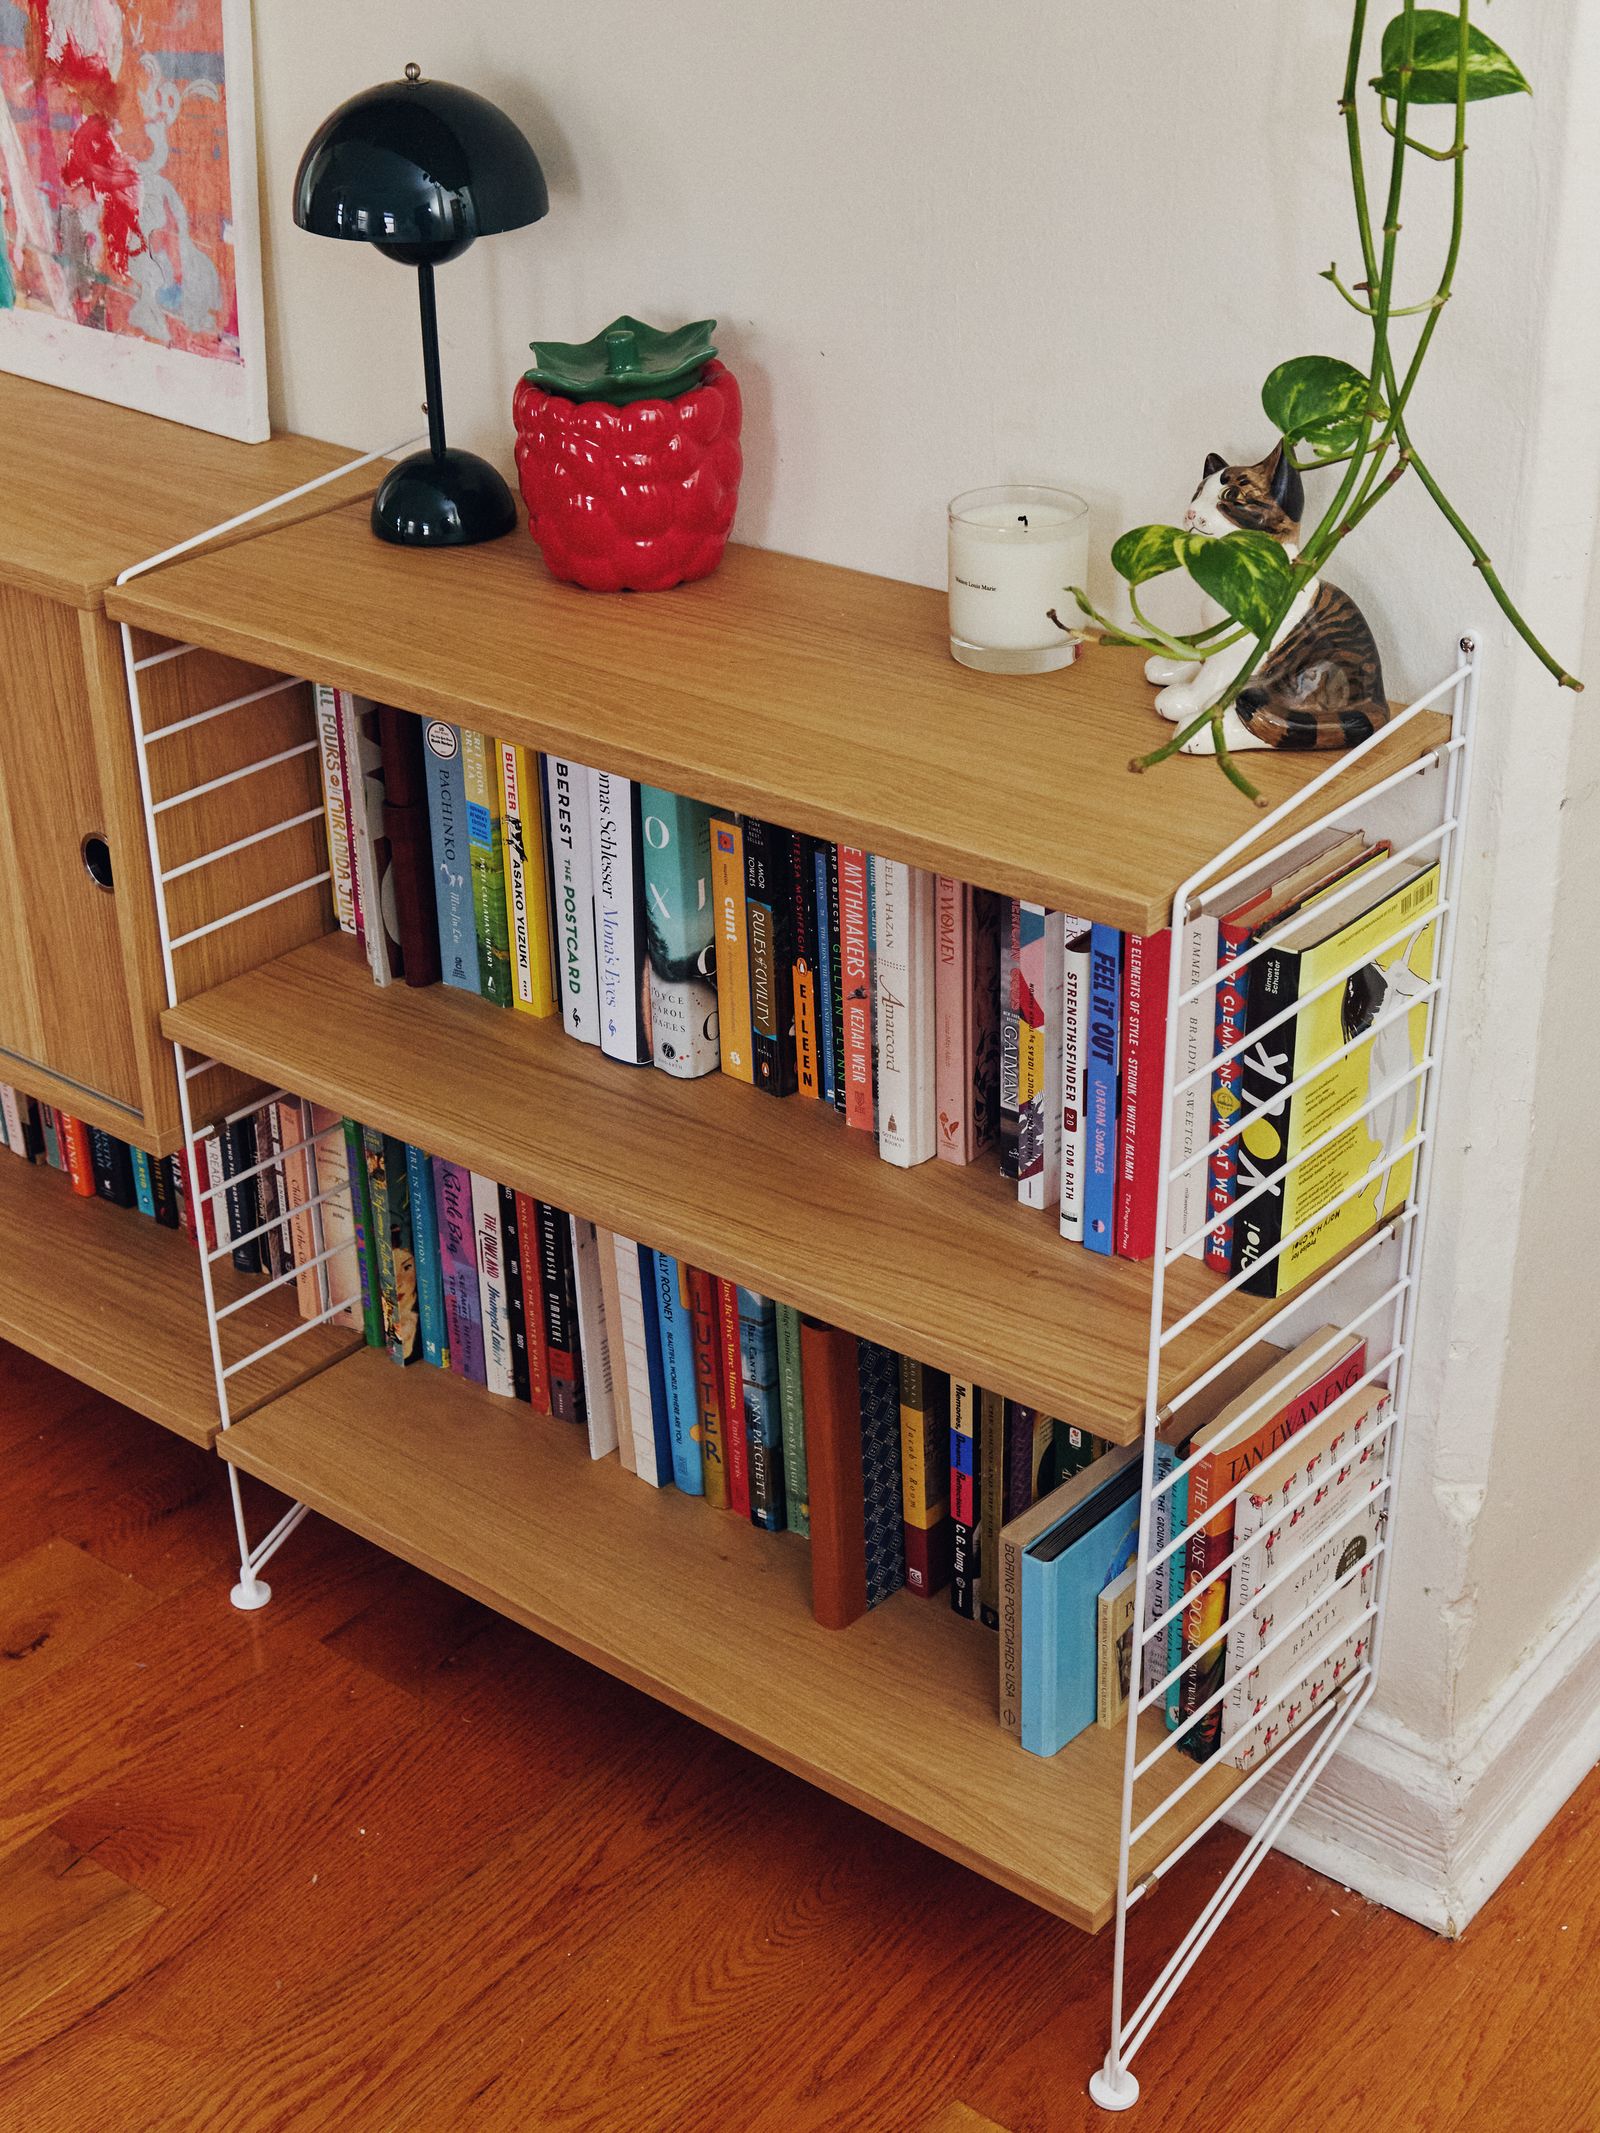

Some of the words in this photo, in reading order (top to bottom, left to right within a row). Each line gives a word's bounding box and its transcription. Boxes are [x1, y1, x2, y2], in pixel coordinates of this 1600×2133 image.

[968, 581, 981, 590] Louis
[981, 584, 997, 592] Marie
[321, 713, 340, 771] FOURS
[505, 752, 516, 811] BUTTER
[439, 768, 456, 861] PACHINKO
[556, 762, 573, 850] BEREST
[329, 796, 350, 880] MIRANDA
[563, 858, 572, 882] THE
[600, 818, 618, 899] Schlesser
[748, 856, 756, 887] TOWLES
[757, 861, 765, 889] AMOR
[512, 859, 524, 911] ASAKO
[339, 884, 355, 931] JULY
[724, 897, 737, 942] cunt
[795, 885, 805, 953] MOSHFEGH
[844, 861, 865, 978] MYTHMAKERS
[516, 916, 528, 969] YUZUKI
[563, 885, 581, 994] POSTCARD
[602, 905, 620, 964] Mona's
[752, 909, 767, 955] RULES
[886, 903, 894, 949] HAZAN
[940, 896, 955, 966] WOMEN
[485, 938, 493, 968] HENRY
[601, 968, 620, 1008] Eyes
[833, 943, 843, 1016] GILLIAN
[1093, 950, 1116, 992] FEEL
[1129, 948, 1142, 999] ELEMENTS
[1265, 969, 1273, 993] Simon
[1272, 960, 1281, 995] Schuster
[651, 986, 685, 1005] JOYCE
[652, 1002, 685, 1019] CAROL
[755, 968, 769, 1027] CIVILITY
[1129, 1001, 1140, 1015] OF
[653, 1015, 686, 1033] OATES
[799, 984, 813, 1087] EILEEN
[850, 1007, 865, 1050] KEZIAH
[879, 974, 905, 1073] Amarcord
[1028, 1036, 1035, 1044] by
[1065, 971, 1078, 1102] STRENGTHSFINDER
[1128, 1016, 1140, 1047] STYLE
[836, 1027, 846, 1080] FLYNN
[1027, 1046, 1035, 1071] IDEAS
[1091, 1022, 1115, 1067] OUT
[852, 1054, 866, 1084] WEIR
[1003, 1025, 1018, 1106] GAIMAN
[1126, 1058, 1139, 1099] STRUNK
[1093, 1080, 1108, 1127] JORDAN
[1126, 1107, 1137, 1136] WHITE
[66, 1136, 78, 1170] KING
[1066, 1143, 1075, 1167] TOM
[1094, 1127, 1107, 1175] SONDLER
[1124, 1143, 1136, 1181] KALMAN
[412, 1177, 420, 1189] IN
[443, 1168, 463, 1220] Rattle
[1065, 1171, 1075, 1201] RATH
[1214, 1178, 1228, 1205] WE
[413, 1192, 426, 1264] TRANSLATION
[483, 1213, 496, 1234] THE
[508, 1225, 515, 1235] UP
[1123, 1204, 1132, 1230] Penguin
[446, 1222, 463, 1255] Bag
[479, 1230, 500, 1279] LOWLAND
[1122, 1231, 1130, 1250] Press
[523, 1233, 532, 1281] MICHAELS
[659, 1252, 670, 1276] ALLY
[458, 1272, 469, 1318] SEAMUS
[485, 1282, 500, 1331] Jhumpa
[513, 1299, 521, 1310] MY
[660, 1277, 673, 1322] ROONEY
[721, 1280, 731, 1303] Just
[529, 1310, 537, 1345] WINTER
[549, 1293, 562, 1343] DIMANCHE
[724, 1304, 732, 1318] Be
[516, 1333, 525, 1350] BODY
[666, 1331, 676, 1363] BEAUTIFUL
[726, 1319, 735, 1341] Five
[747, 1324, 756, 1344] BEL
[532, 1352, 540, 1378] VAULT
[728, 1343, 737, 1369] More
[748, 1347, 758, 1382] CANTO
[695, 1291, 721, 1464] LUSTER
[729, 1369, 738, 1410] Minutes
[785, 1368, 794, 1410] CLAIRE
[671, 1392, 680, 1414] WHERE
[750, 1393, 761, 1427] ANN
[955, 1384, 966, 1430] Memories,
[674, 1429, 682, 1445] YOU
[1227, 1441, 1264, 1482] TAN
[1323, 1363, 1360, 1411] ENG
[753, 1428, 766, 1500] PATCHETT
[789, 1438, 797, 1458] SEA
[905, 1424, 918, 1472] Jacob's
[955, 1434, 966, 1467] Dreams,
[789, 1461, 798, 1496] LIGHT
[909, 1477, 918, 1509] Room
[955, 1471, 966, 1517] Reflections
[1194, 1476, 1208, 1504] THE
[1158, 1495, 1166, 1512] THE
[955, 1524, 966, 1534] C.
[955, 1535, 966, 1546] G.
[1156, 1517, 1165, 1548] GROUND
[954, 1547, 966, 1573] Jung
[1004, 1544, 1014, 1594] BORING
[1294, 1540, 1348, 1592] SELLOUT
[1155, 1584, 1163, 1592] IN
[1239, 1555, 1251, 1606] SELLOUT
[1154, 1594, 1163, 1610] ITS
[1004, 1597, 1014, 1676] POSTCARDS
[1235, 1632, 1245, 1658] PAUL
[1293, 1607, 1338, 1654] BEATTY
[1005, 1677, 1014, 1699] USA
